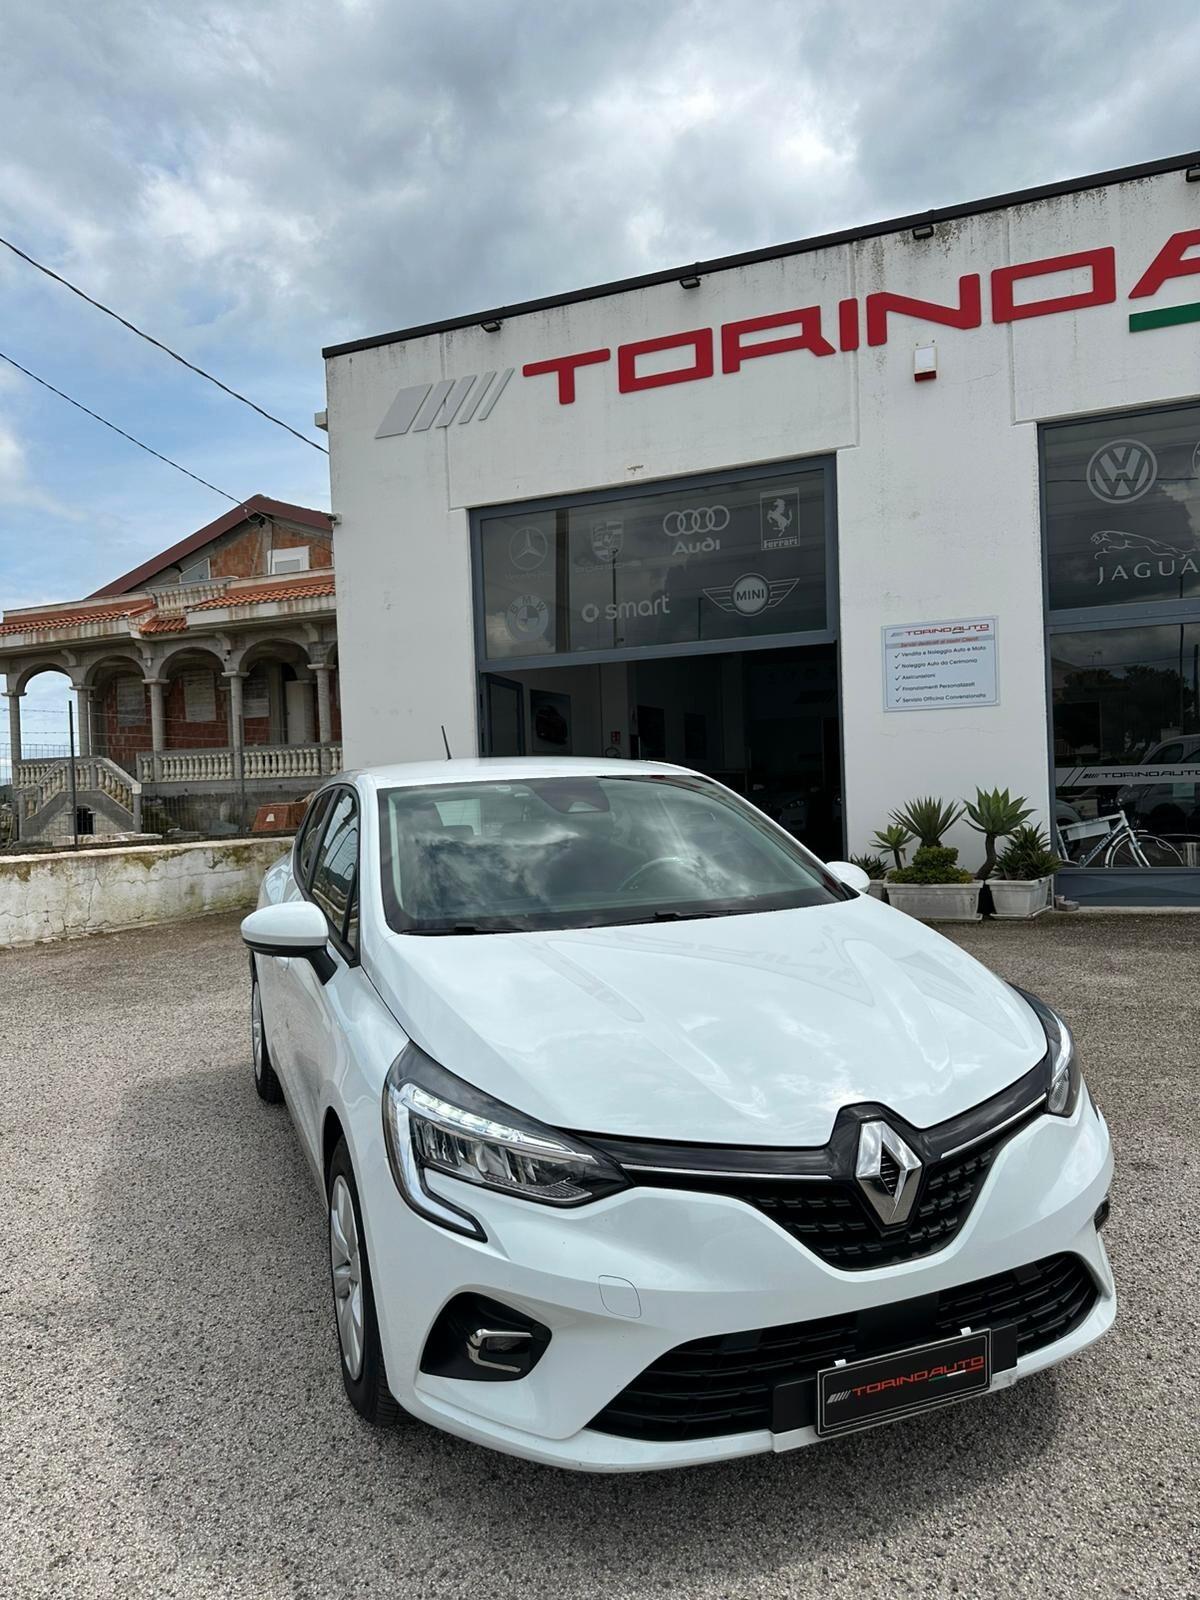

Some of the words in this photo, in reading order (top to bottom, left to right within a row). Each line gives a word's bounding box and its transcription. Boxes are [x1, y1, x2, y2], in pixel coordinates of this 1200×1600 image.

[672, 537, 721, 556] Audi
[763, 536, 798, 549] Ferrari
[1096, 558, 1200, 586] JAGUA
[736, 588, 765, 601] MINI
[605, 595, 670, 620] smart
[905, 623, 989, 636] TORINOAUTO
[928, 647, 952, 656] Noleggio
[902, 662, 926, 670] Noleggio
[949, 658, 977, 666] Cerimonia
[902, 684, 938, 692] Finanziamenti
[924, 694, 944, 702] Officina
[945, 692, 986, 701] Convenzionata
[852, 1355, 984, 1396] TORINOAUTO
